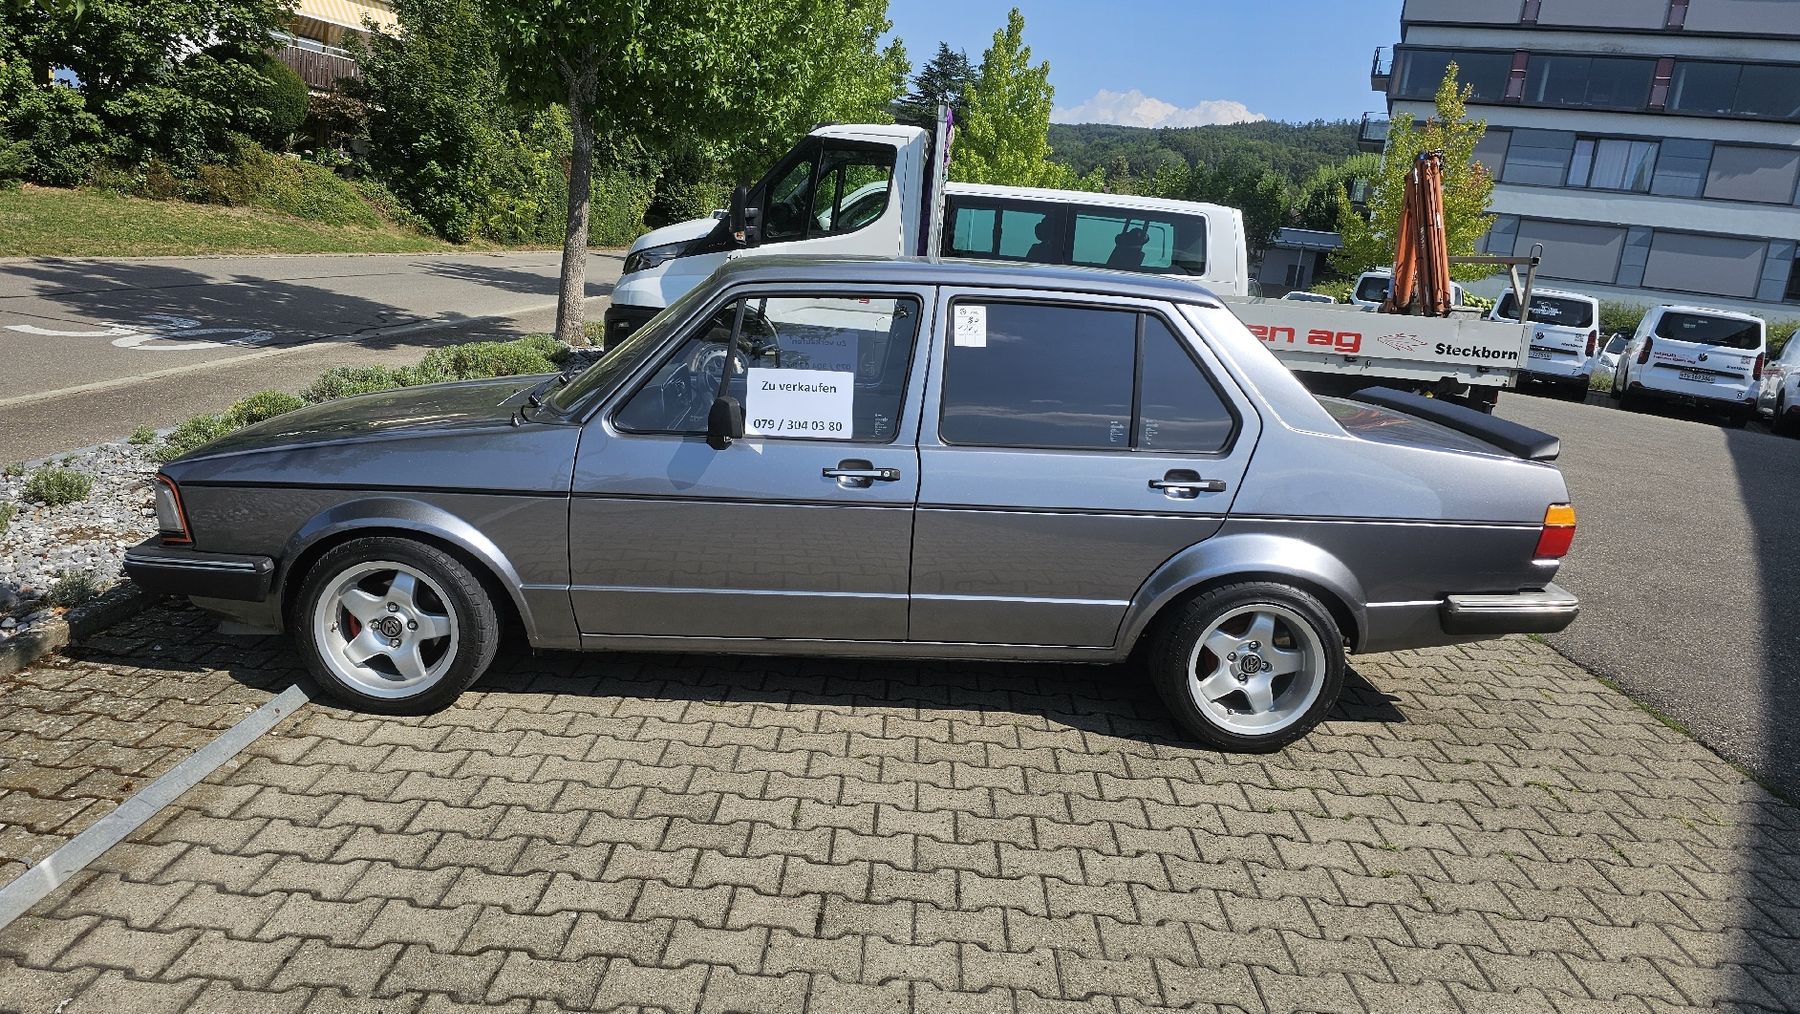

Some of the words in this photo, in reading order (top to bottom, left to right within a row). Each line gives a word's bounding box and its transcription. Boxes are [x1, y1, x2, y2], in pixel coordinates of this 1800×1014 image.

[1307, 329, 1362, 353] ag
[1435, 342, 1518, 360] Steckborn
[761, 380, 776, 391] Zu
[779, 382, 837, 393] verkaufen
[753, 418, 775, 429] 079
[777, 419, 784, 431] /
[786, 420, 808, 430] 304
[811, 420, 825, 431] 03
[828, 421, 843, 431] 80
